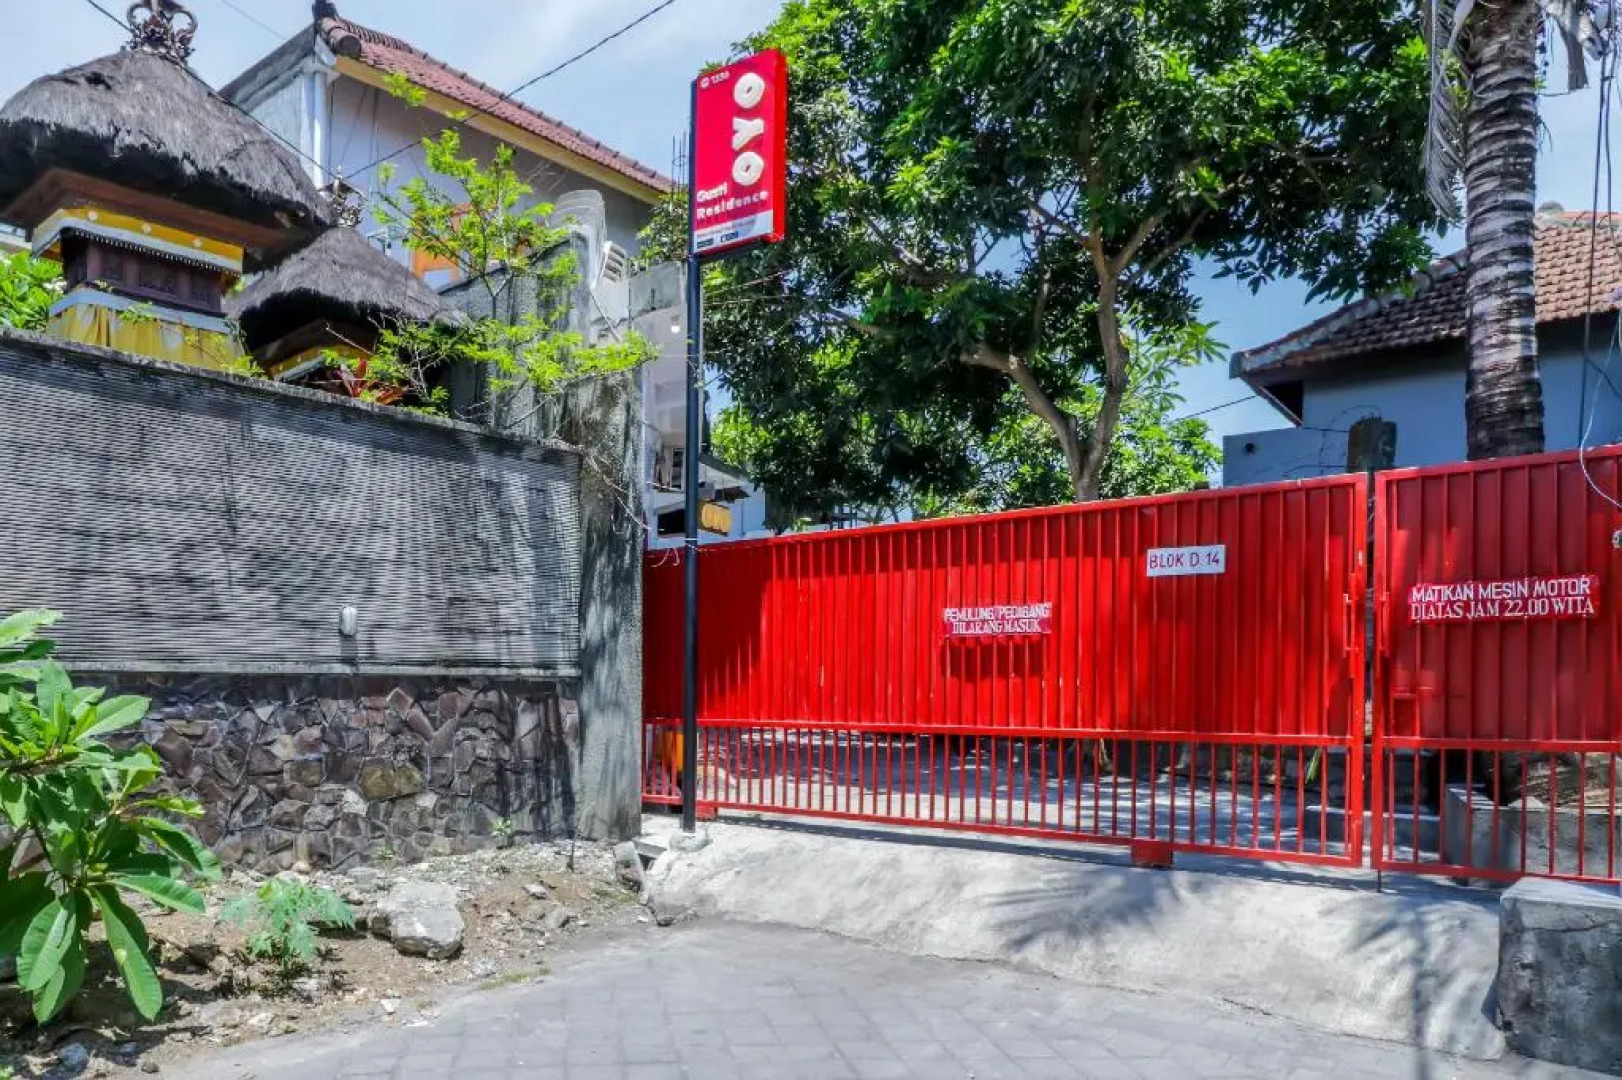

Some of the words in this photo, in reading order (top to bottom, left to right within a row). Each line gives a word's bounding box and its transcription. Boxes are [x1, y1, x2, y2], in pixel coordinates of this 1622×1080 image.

[732, 72, 765, 186] OYO
[697, 191, 768, 219] Residence
[1149, 553, 1185, 569] BLOK
[1204, 550, 1219, 566] 14
[1412, 584, 1473, 602] MATIKAN
[1479, 579, 1528, 600] MESIN
[1533, 577, 1590, 597] MOTOR
[1411, 602, 1463, 620] DIATAS
[1466, 600, 1499, 619] JAM
[1503, 598, 1549, 618] 22.00
[1551, 596, 1594, 616] WITA
[953, 620, 1002, 634] DILARANG
[1004, 618, 1040, 633] MASUK
